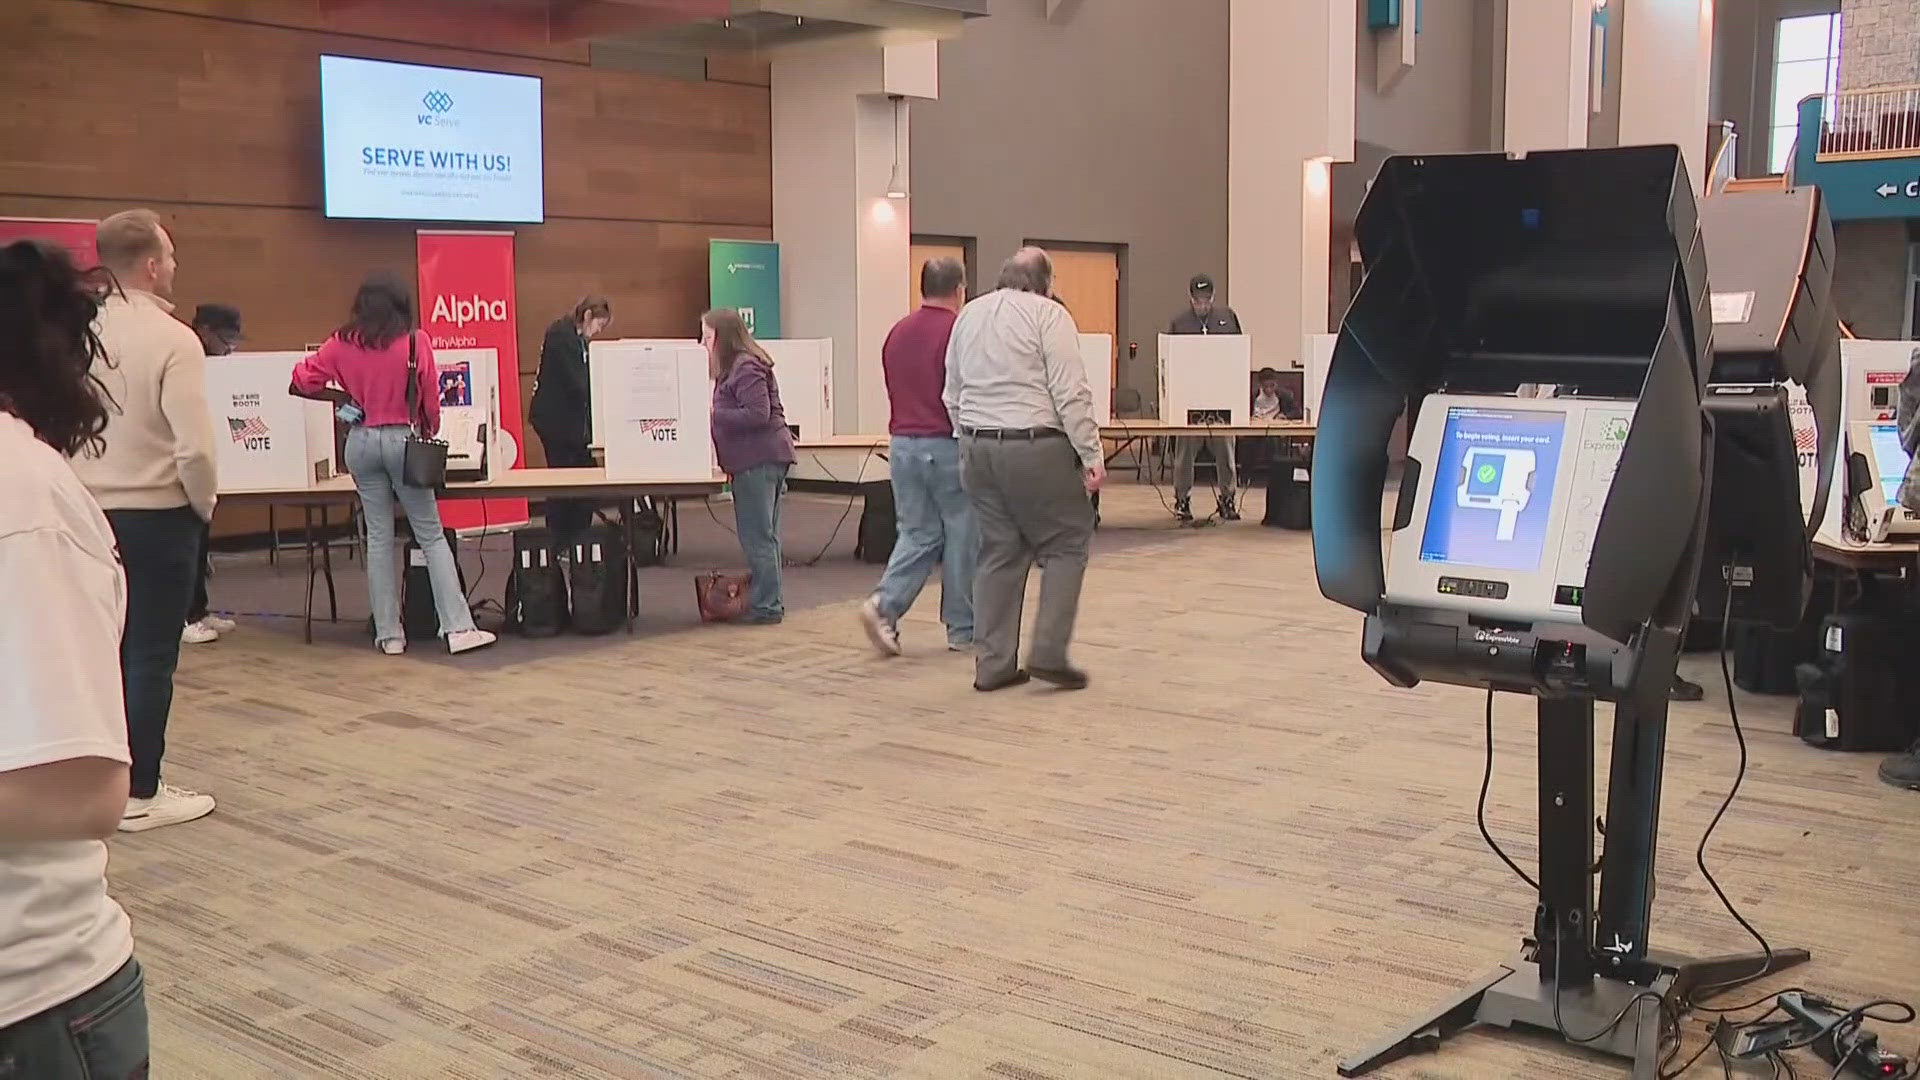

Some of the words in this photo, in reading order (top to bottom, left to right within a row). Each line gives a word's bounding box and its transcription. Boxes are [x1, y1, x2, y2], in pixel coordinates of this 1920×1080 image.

[418, 114, 432, 125] VC
[362, 146, 425, 168] SERVE
[430, 150, 478, 171] WITH
[483, 154, 511, 172] US!
[430, 294, 507, 328] Alpha
[432, 335, 477, 348] #TryAlpha
[651, 428, 678, 441] VOTE
[243, 437, 271, 450] VOTE
